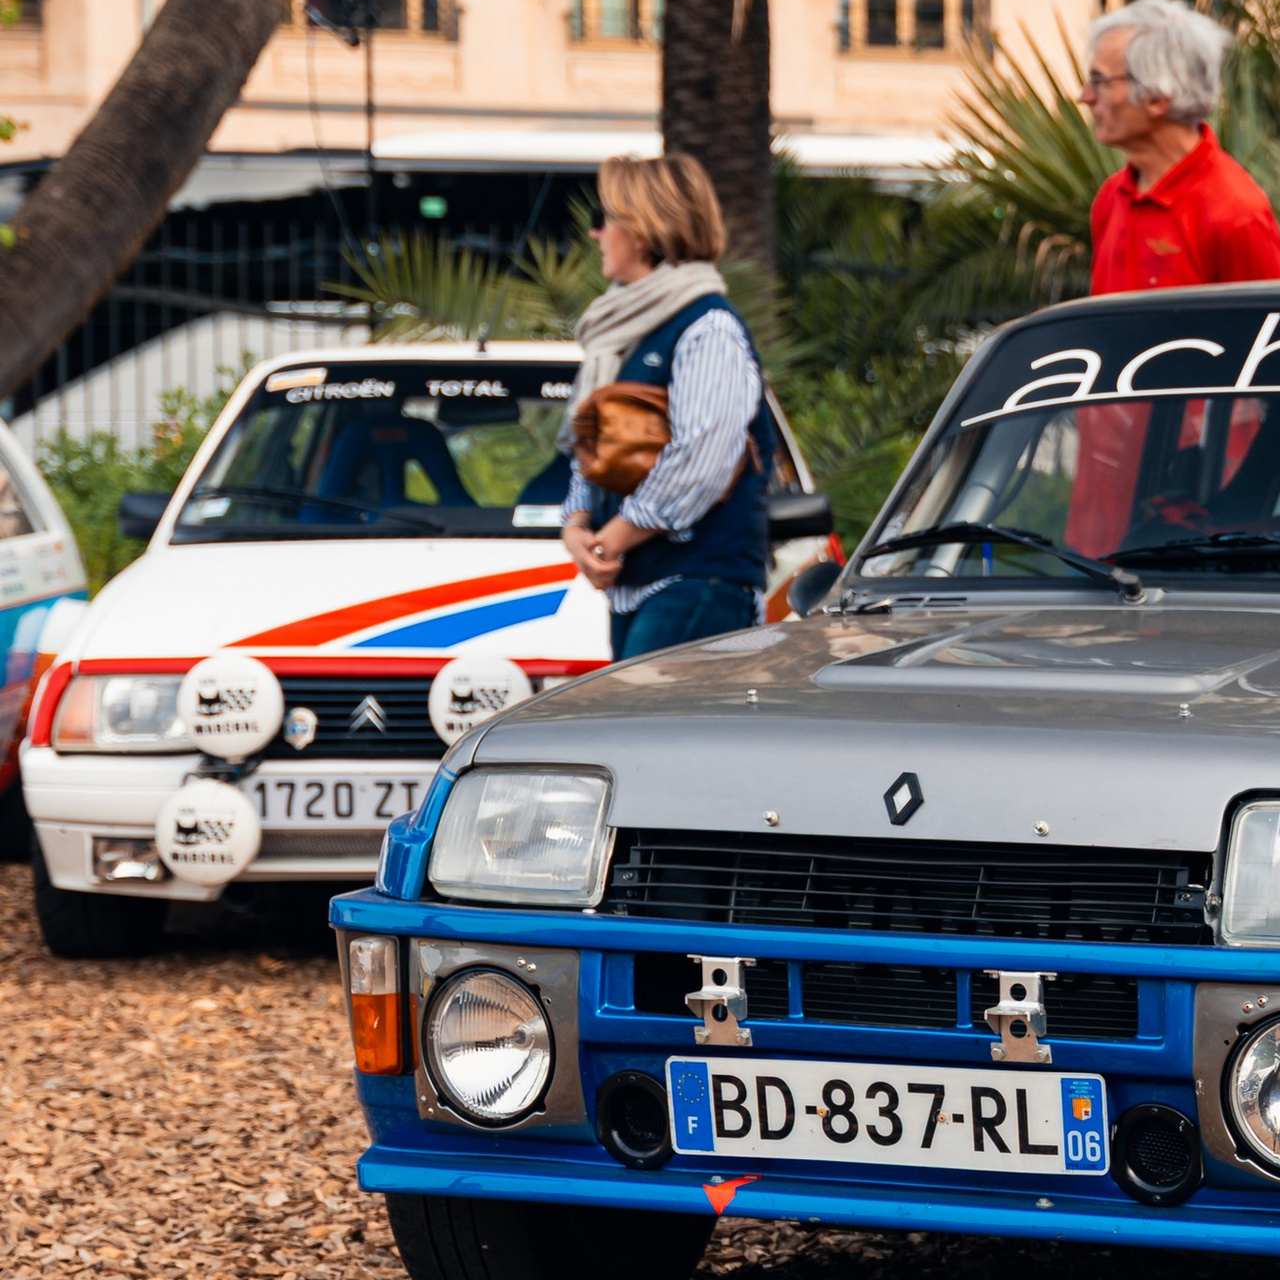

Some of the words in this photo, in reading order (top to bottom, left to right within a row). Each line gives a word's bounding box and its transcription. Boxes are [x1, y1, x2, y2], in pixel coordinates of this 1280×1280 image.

[286, 377, 396, 404] CITROËN
[425, 379, 510, 397] TOTAL
[254, 781, 353, 819] 1720
[687, 1116, 699, 1136] F
[711, 1073, 1059, 1156] BD-837-RL
[1067, 1130, 1102, 1162] 06
